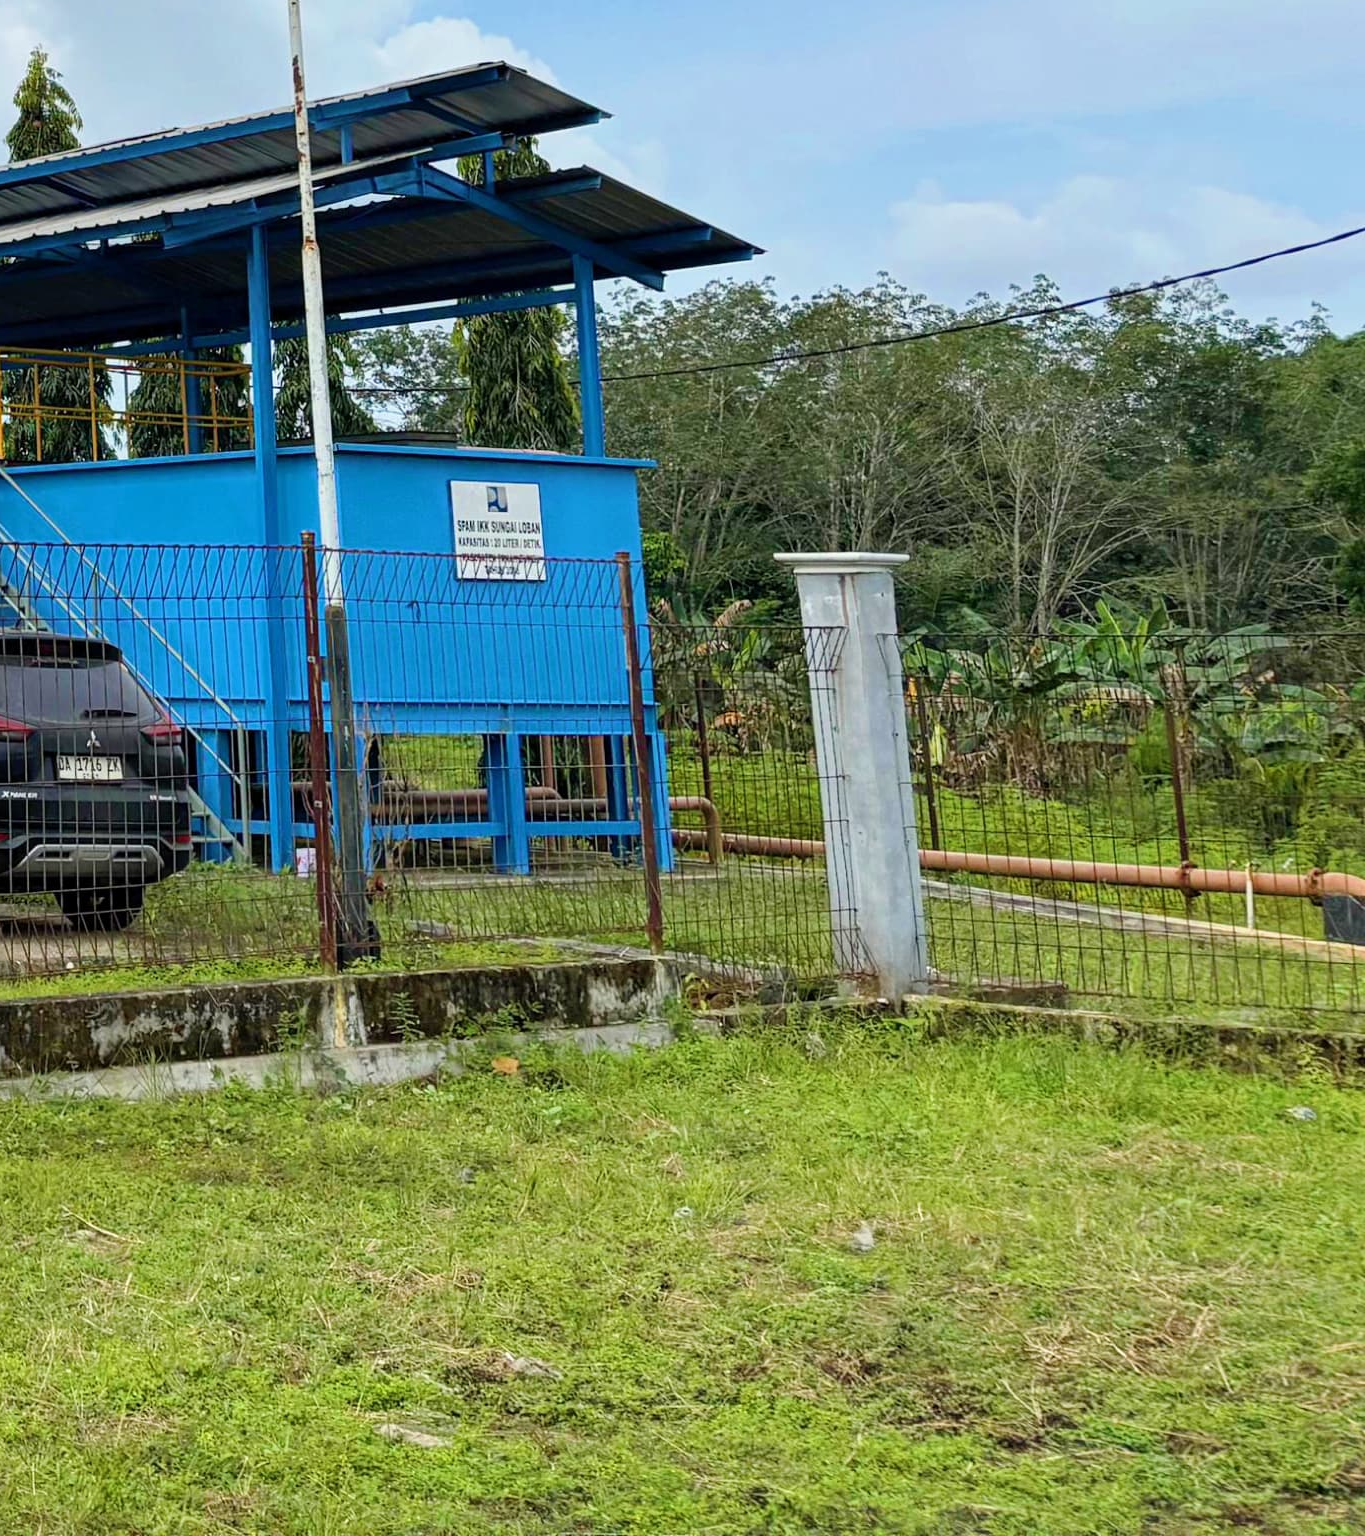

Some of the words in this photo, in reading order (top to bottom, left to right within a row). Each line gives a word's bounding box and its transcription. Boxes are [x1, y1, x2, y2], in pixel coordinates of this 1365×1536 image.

[457, 520, 475, 532] SPAM
[477, 521, 489, 533] IKK
[491, 521, 517, 534] SUNGAI
[519, 522, 541, 534] LOBAN
[458, 537, 489, 548] KAPASITAS
[502, 539, 519, 549] LITER
